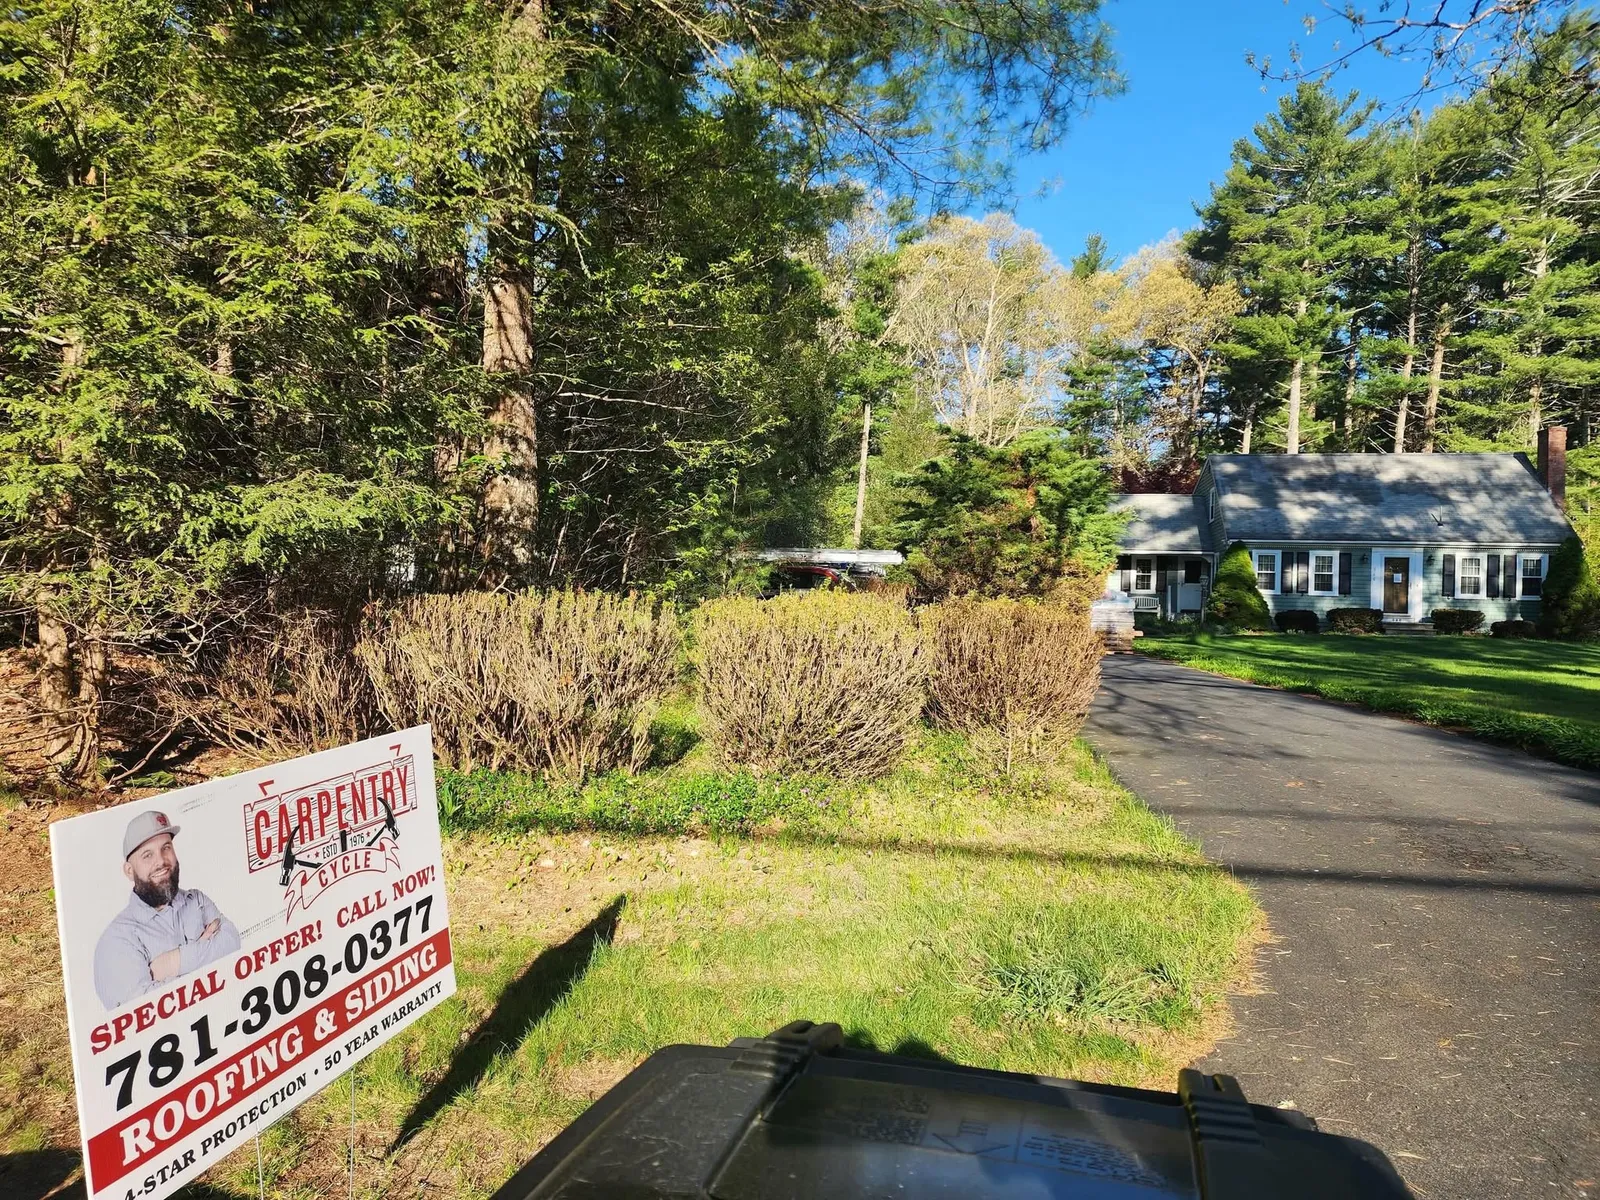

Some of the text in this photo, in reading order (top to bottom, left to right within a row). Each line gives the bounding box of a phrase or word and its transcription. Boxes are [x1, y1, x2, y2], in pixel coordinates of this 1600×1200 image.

[254, 765, 408, 860] CARPENTRY
[318, 851, 371, 888] CYCLE
[349, 833, 365, 848] 1976
[91, 865, 436, 1054] SPECIAL OFFER! CALL NOW!
[105, 896, 433, 1112] 781-308-0377
[120, 944, 437, 1166] ROOFING & SIDING
[125, 981, 442, 1200] 4-STAR PROTECTION 50 YEAR WARRANTY
